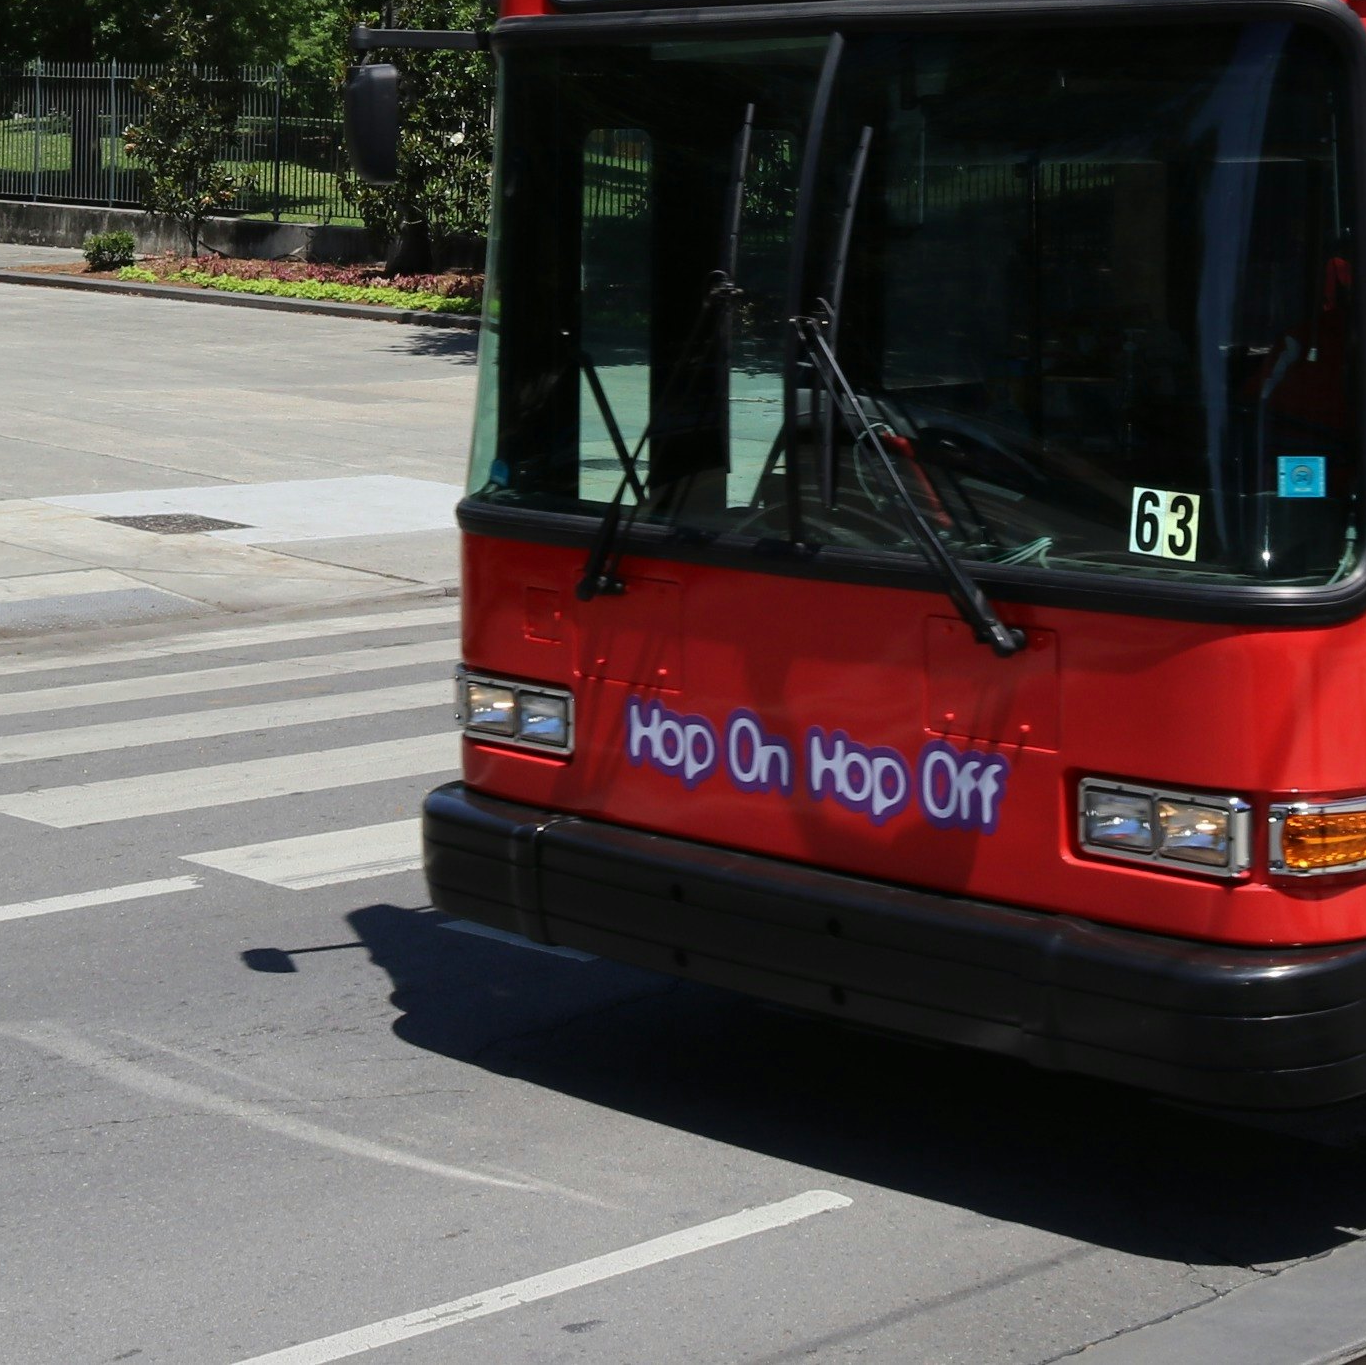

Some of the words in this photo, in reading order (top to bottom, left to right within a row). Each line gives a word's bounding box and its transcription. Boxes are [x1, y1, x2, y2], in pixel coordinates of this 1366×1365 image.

[1135, 490, 1195, 557] 63
[628, 702, 716, 783] Hop
[726, 715, 790, 788] On
[808, 733, 908, 818] Hop
[920, 747, 1004, 826] Off
